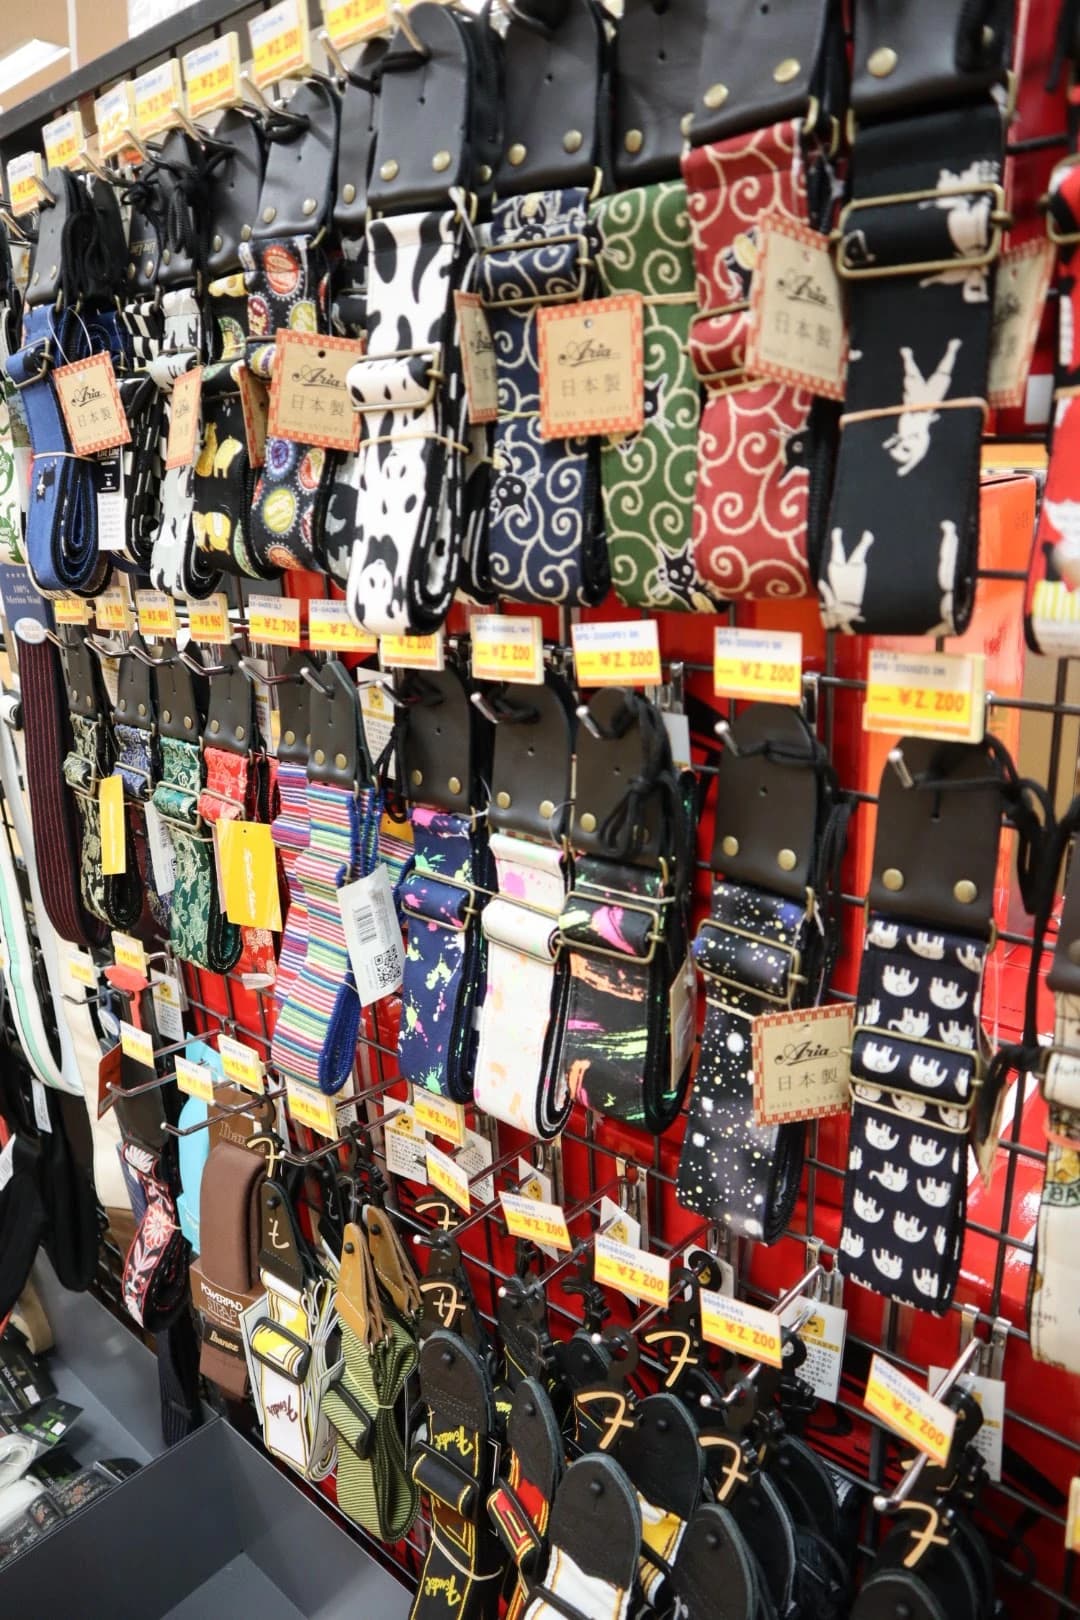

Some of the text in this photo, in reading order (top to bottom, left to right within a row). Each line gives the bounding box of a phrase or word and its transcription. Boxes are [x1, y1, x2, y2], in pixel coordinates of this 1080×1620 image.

[776, 268, 835, 311] Aria
[558, 338, 621, 367] Aria
[292, 364, 348, 391] Aria
[561, 373, 621, 397] 日本製
[71, 386, 107, 408] Aria
[291, 394, 345, 417] 日本製
[77, 407, 113, 428] 日本製
[774, 1040, 840, 1066] Aria
[778, 1067, 838, 1092] 日本製
[617, 1264, 665, 1292] ¥2,200
[200, 1282, 244, 1312] POWERPAD
[207, 1299, 238, 1320] STRAP
[209, 1331, 240, 1352] Ibanez
[725, 1321, 777, 1350] ¥2,200
[892, 1396, 946, 1447] ¥2,200
[434, 1424, 474, 1457] Fender
[424, 1574, 462, 1607] Fender
